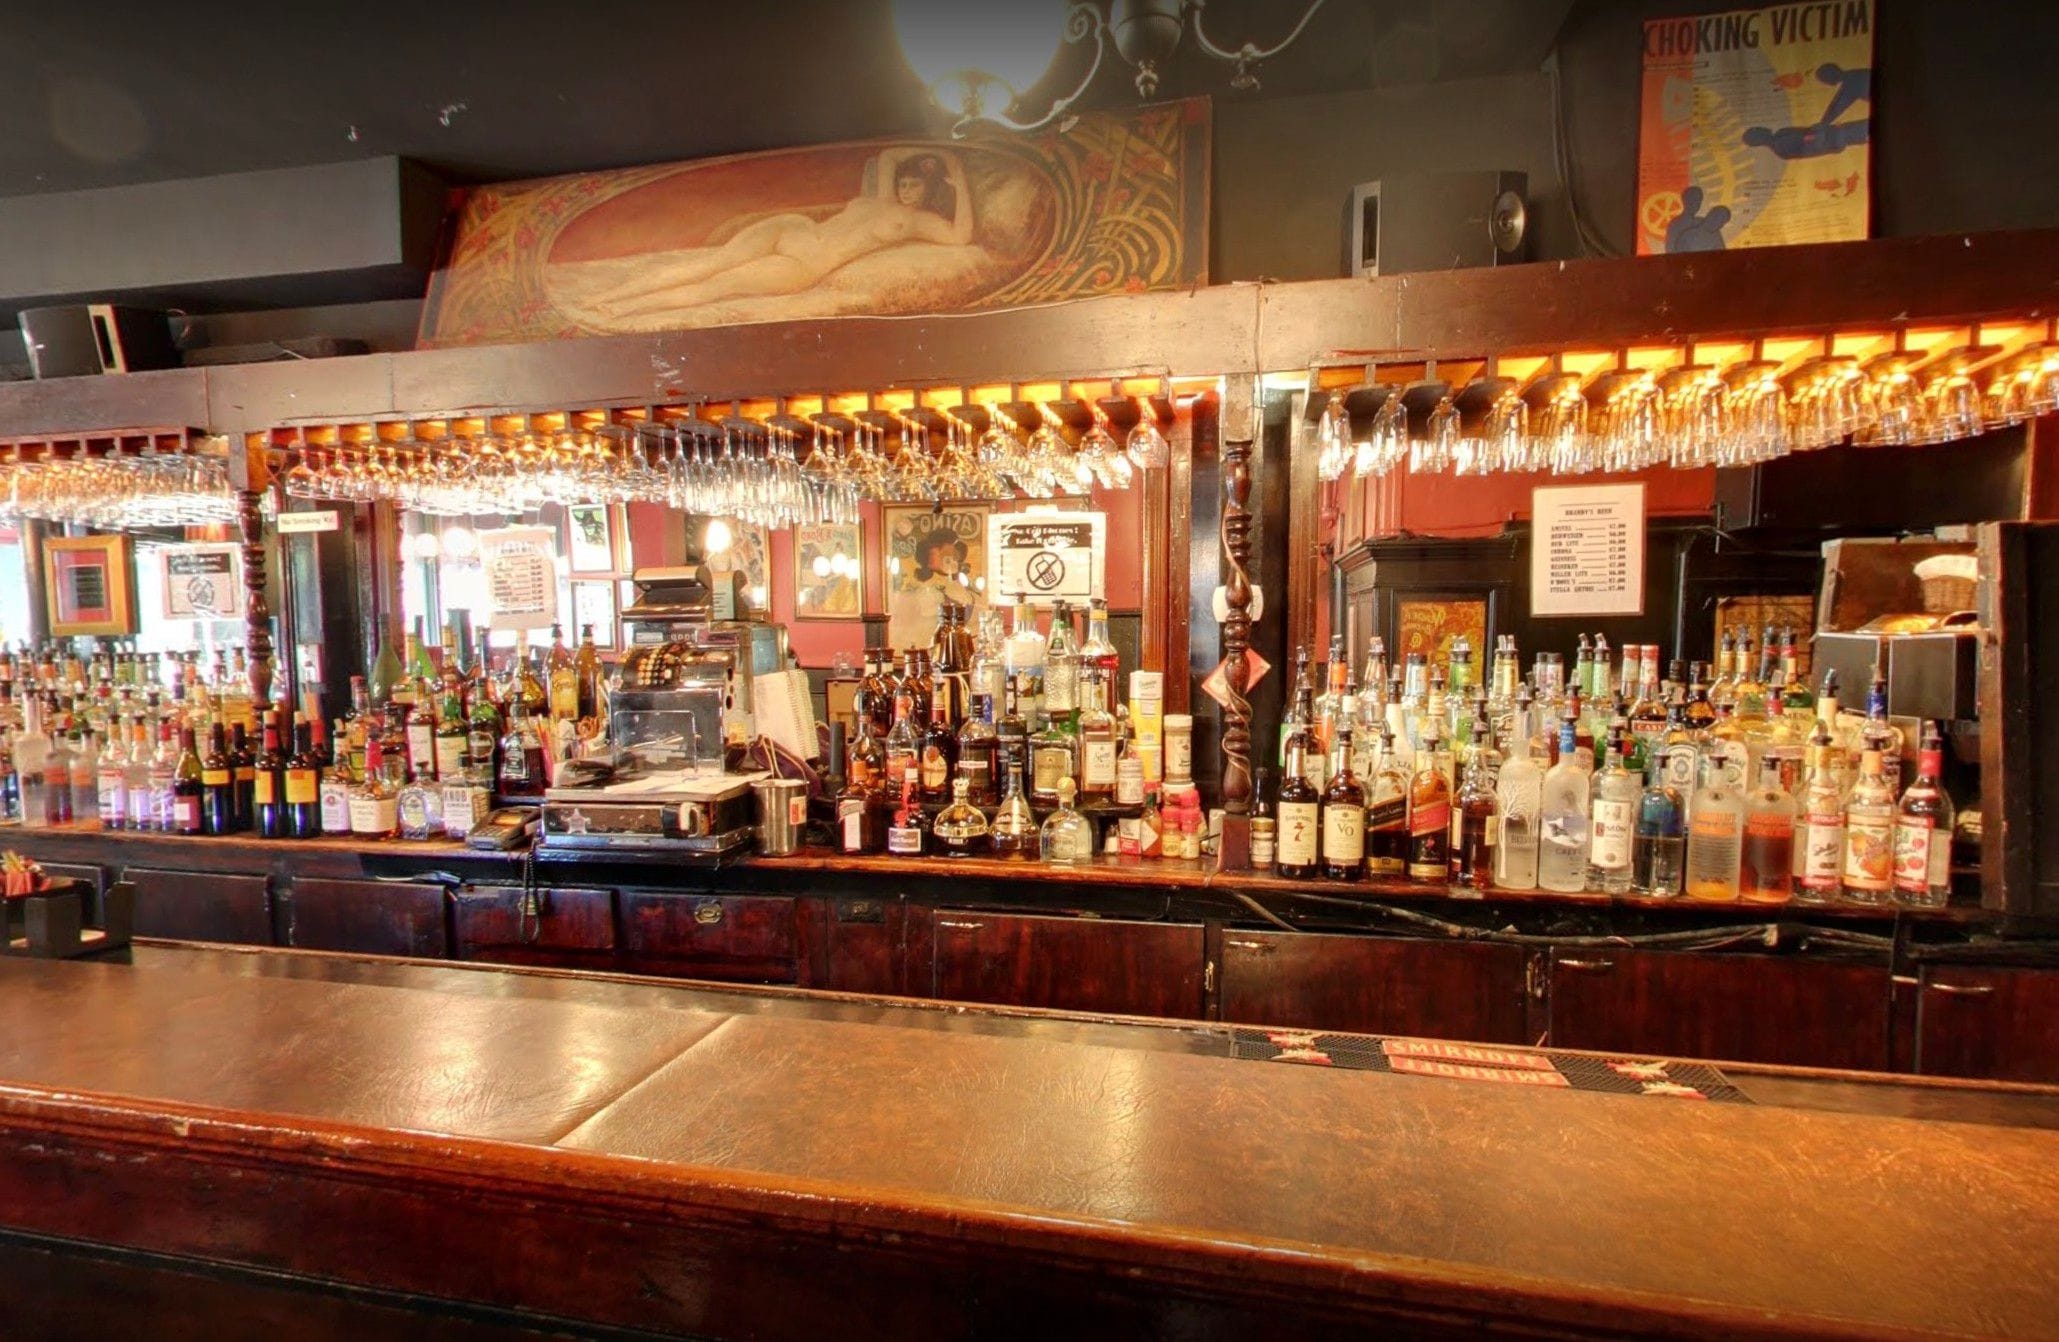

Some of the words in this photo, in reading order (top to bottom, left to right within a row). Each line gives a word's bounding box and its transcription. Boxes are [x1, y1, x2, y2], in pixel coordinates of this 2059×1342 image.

[1645, 13, 1760, 58] CHOKING
[1770, 0, 1869, 46] VICTIM
[1391, 1042, 1540, 1067] SMIRNOFF
[1406, 1058, 1558, 1083] SMIRNOFF
